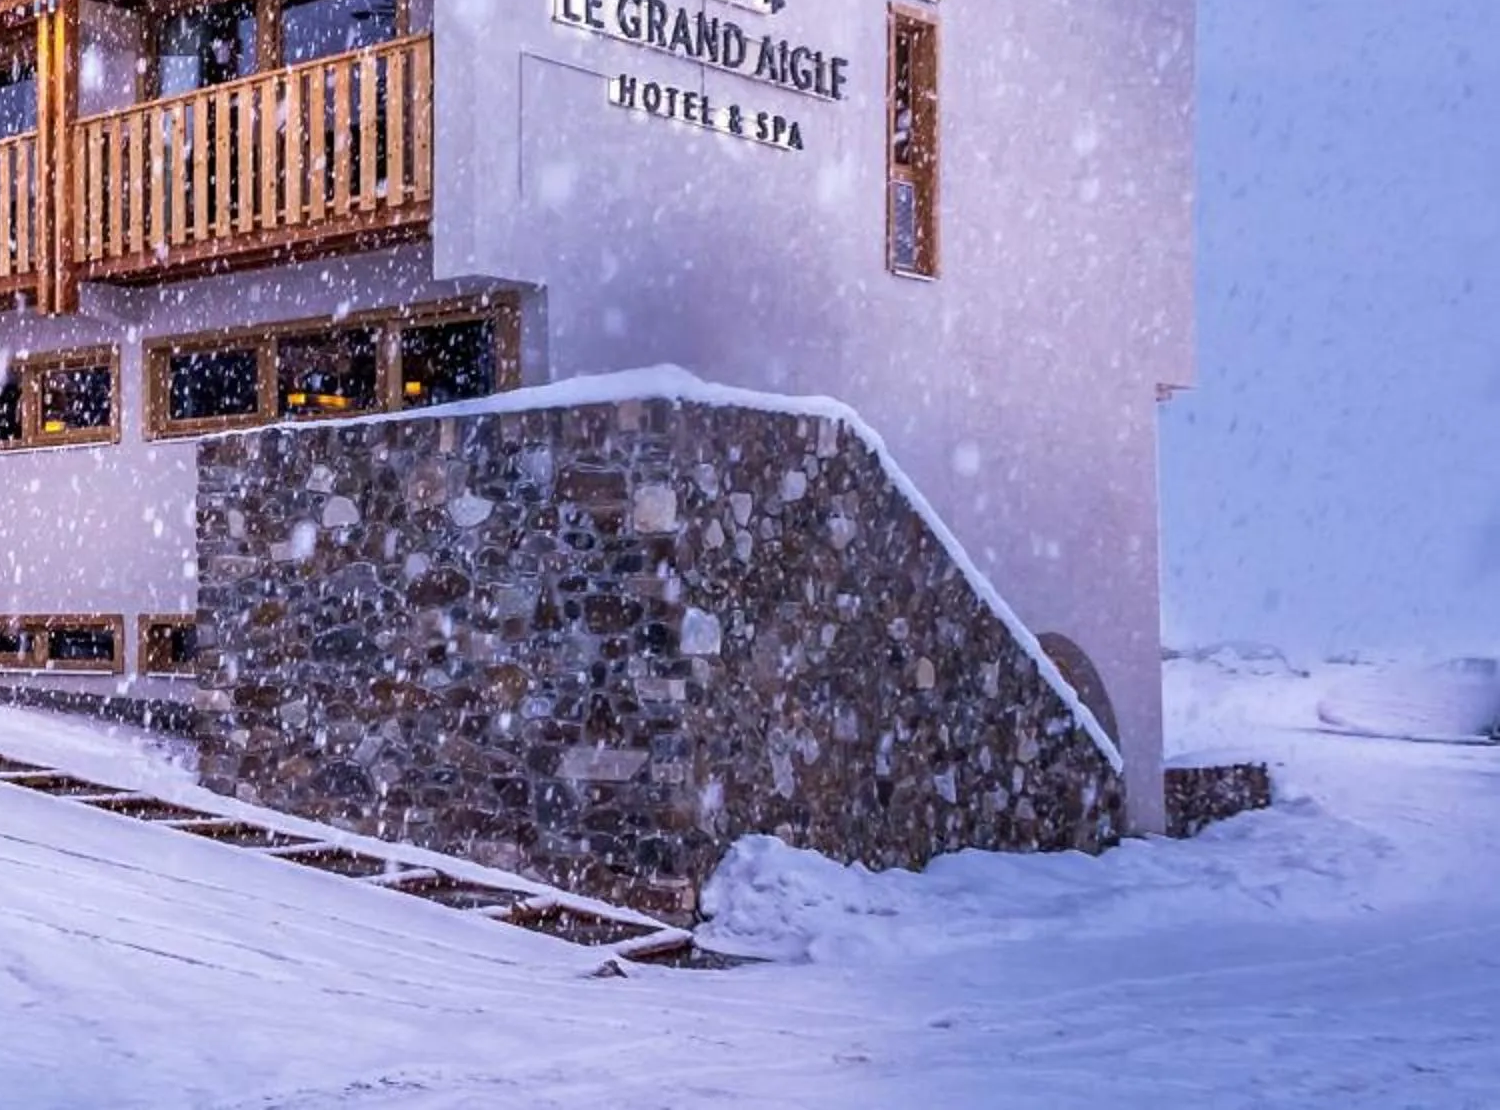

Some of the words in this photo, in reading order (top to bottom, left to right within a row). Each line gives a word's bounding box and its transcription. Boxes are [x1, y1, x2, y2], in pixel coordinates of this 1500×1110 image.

[754, 35, 849, 101] AIGLE
[618, 73, 715, 127] HOTEL
[728, 103, 743, 135] &
[755, 111, 804, 151] SPA
